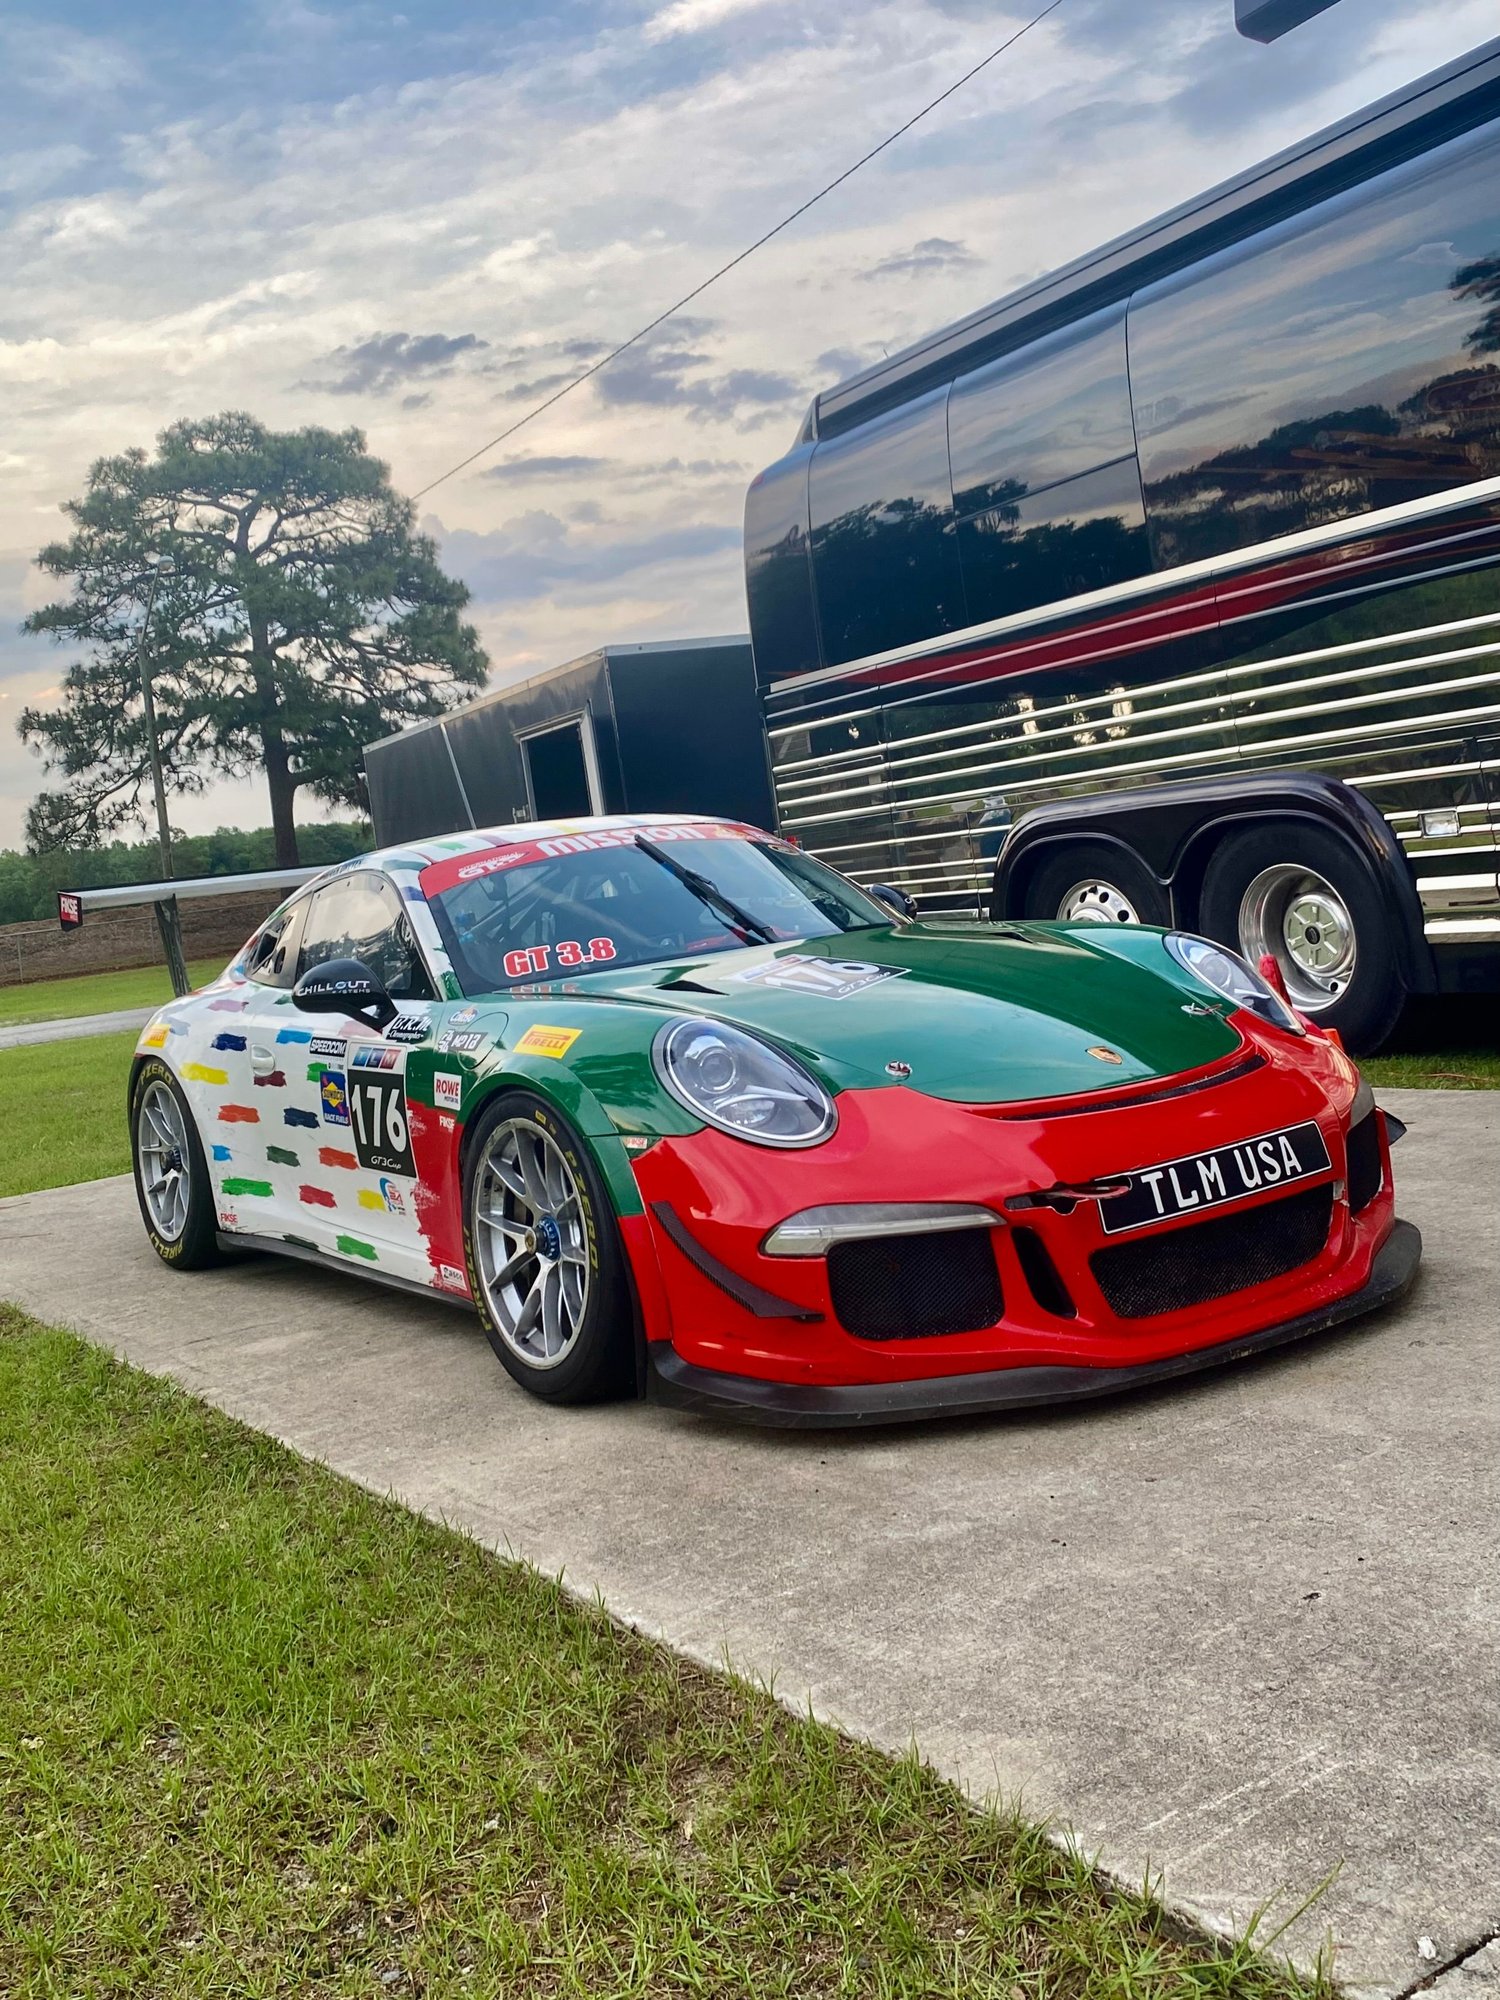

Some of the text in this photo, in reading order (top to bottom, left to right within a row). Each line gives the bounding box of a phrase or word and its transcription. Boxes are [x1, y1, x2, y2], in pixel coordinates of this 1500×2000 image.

[536, 825, 707, 856] mission
[503, 937, 616, 977] GT 3.8
[297, 980, 371, 997] CHILLOUT
[765, 959, 880, 992] 176
[310, 1039, 347, 1056] SPEEDCOM
[436, 1079, 460, 1097] ROWE
[351, 1084, 407, 1153] 176
[1141, 1135, 1302, 1214] TLM USA
